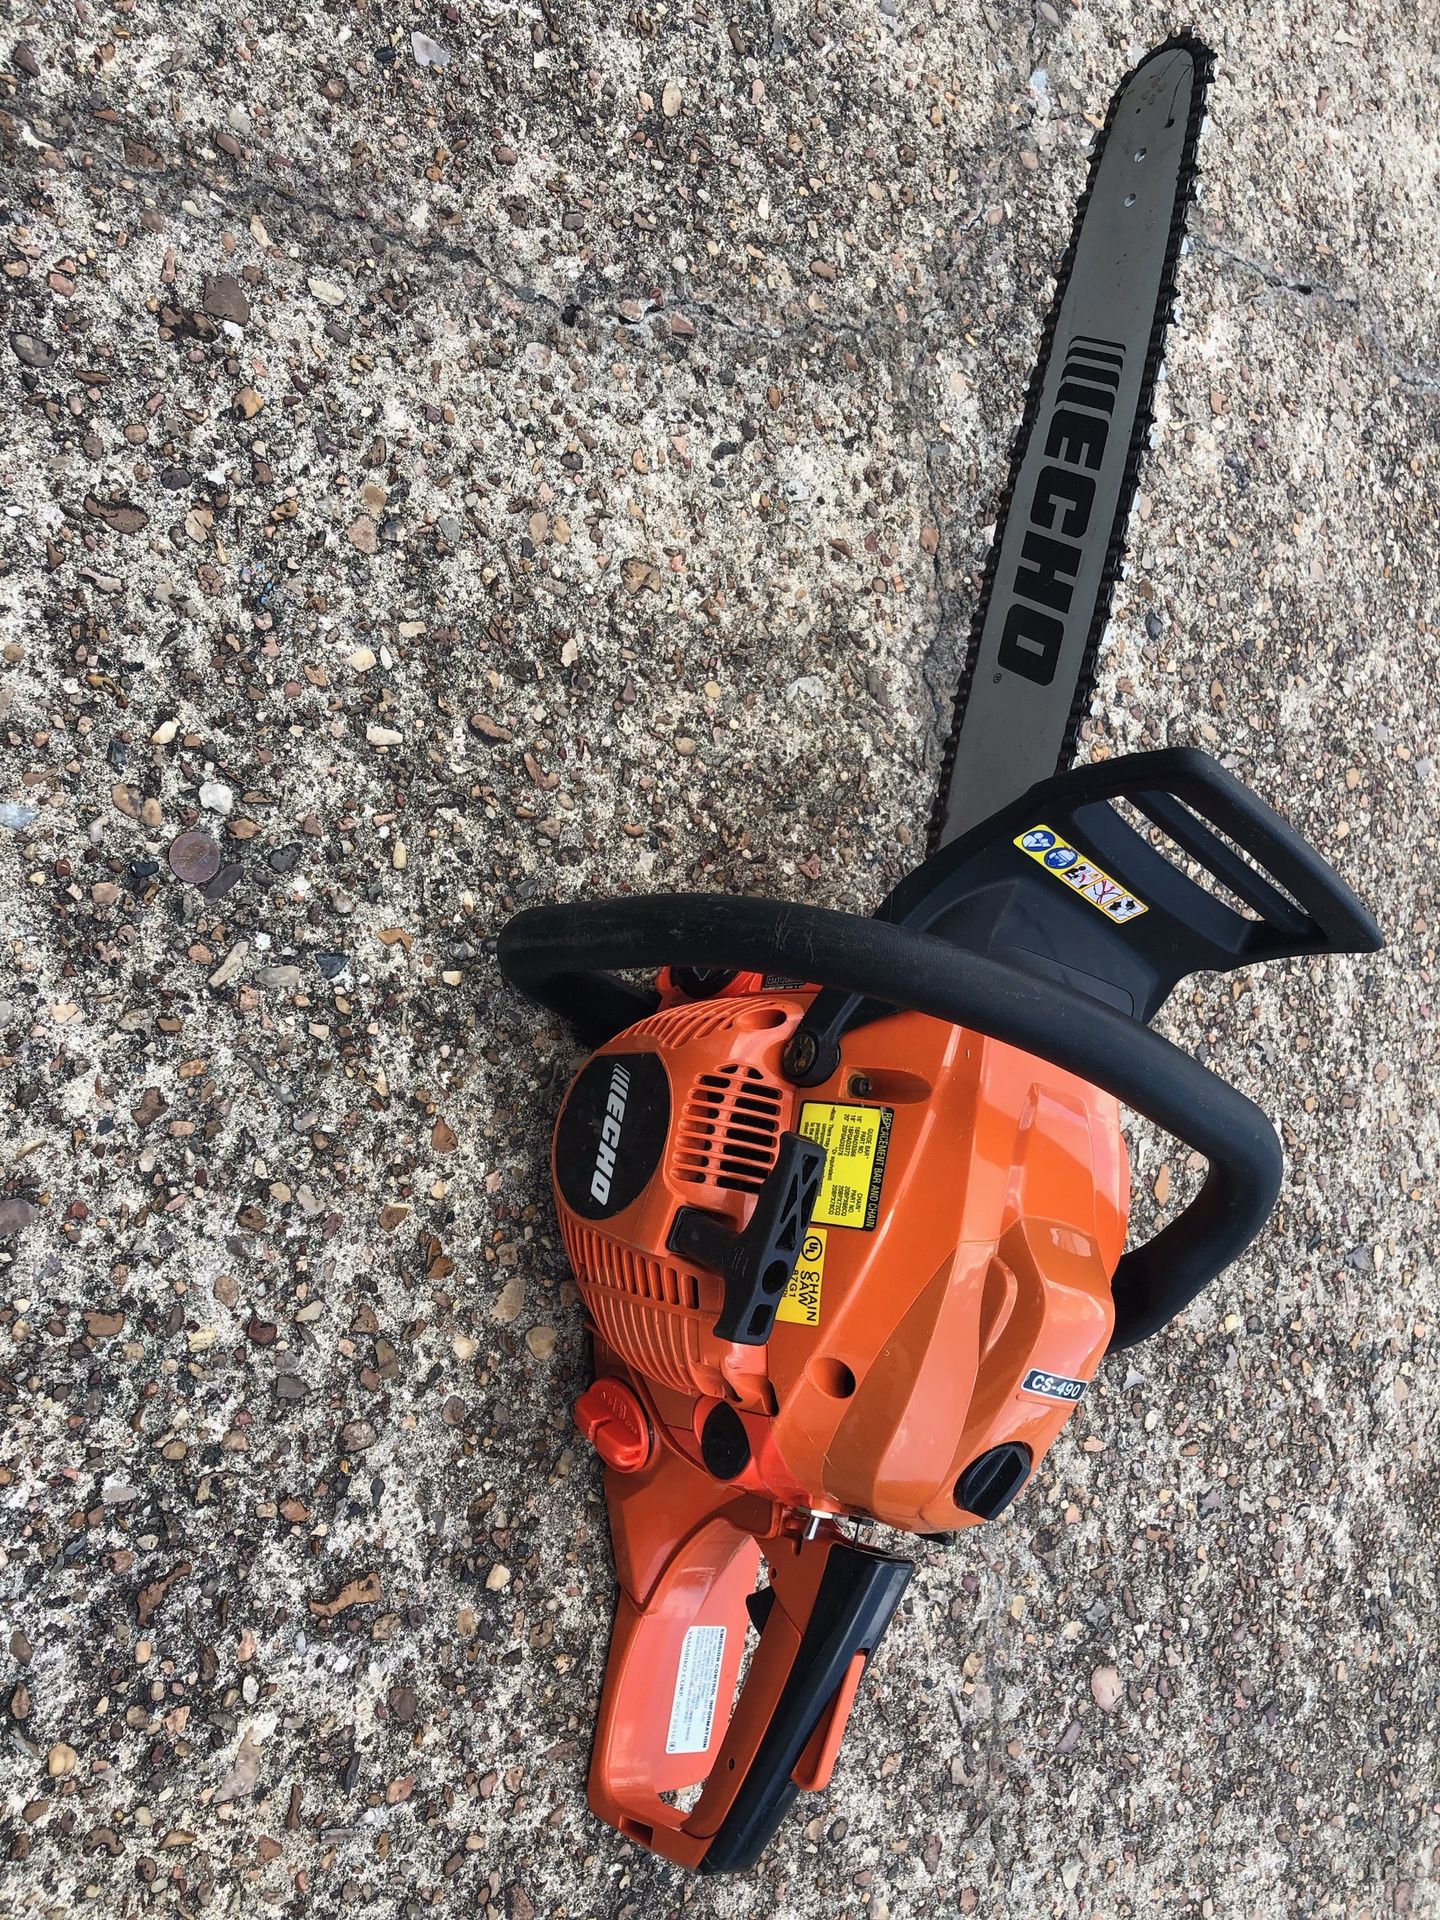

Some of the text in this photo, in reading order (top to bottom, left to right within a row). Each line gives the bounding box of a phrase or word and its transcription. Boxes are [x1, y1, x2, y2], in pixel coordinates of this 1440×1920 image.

[997, 408, 1109, 686] ECHO
[590, 1090, 627, 1206] ECHO
[865, 1128, 873, 1144] GUIDE
[826, 1155, 836, 1180] equivalent
[866, 1112, 892, 1227] REPLACEMENT BAR AND CHAIN
[789, 1269, 798, 1297] 87G1
[797, 1270, 811, 1305] SAW
[806, 1271, 820, 1321] CHAIN
[1032, 1374, 1081, 1398] CS-490
[710, 1663, 719, 1696] CONTROL
[702, 1700, 713, 1748] INFORMATION
